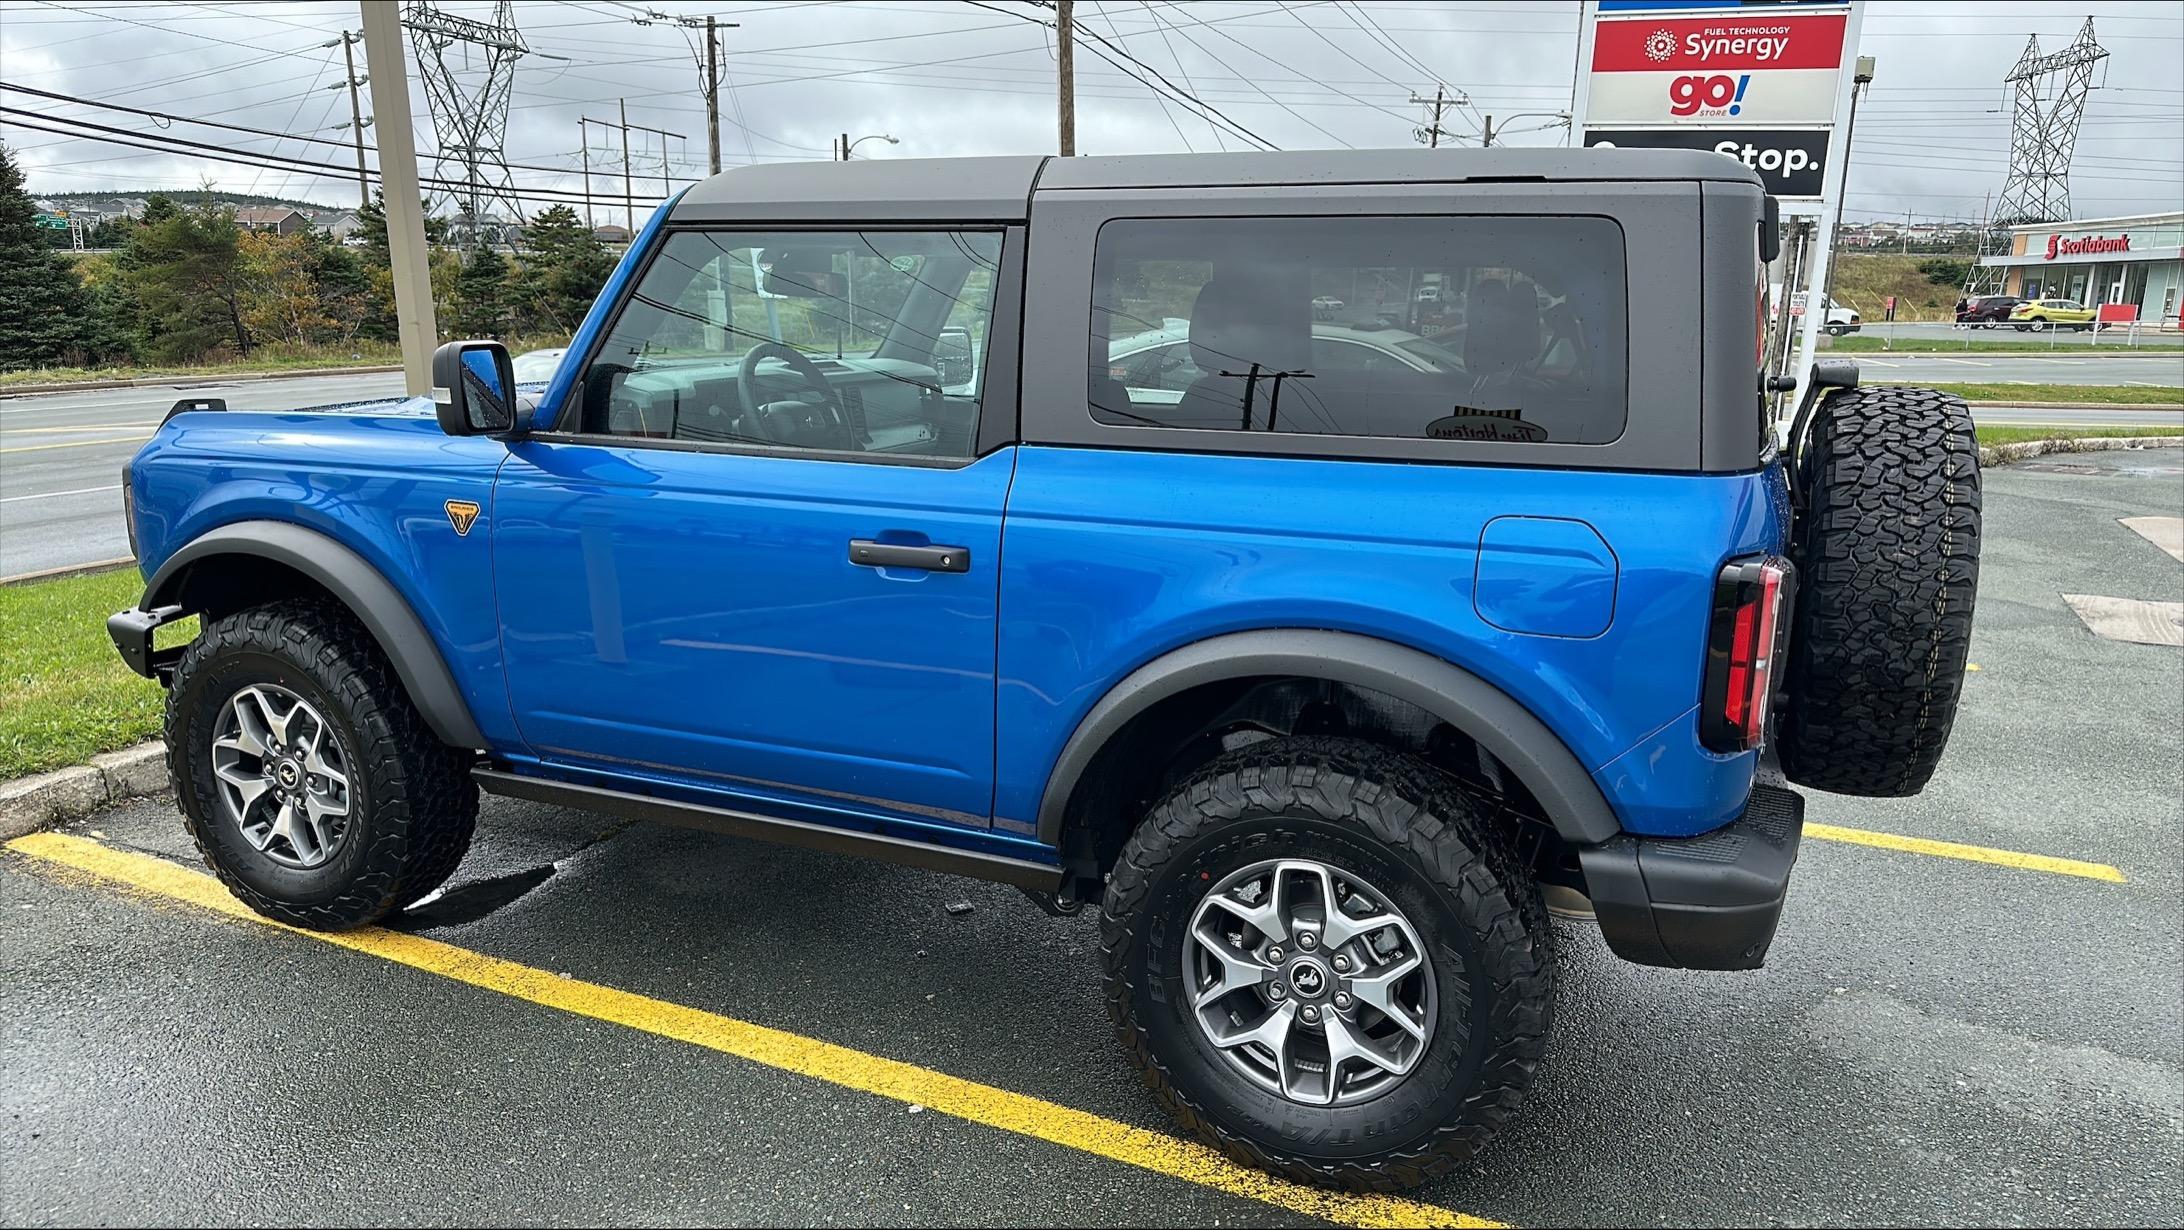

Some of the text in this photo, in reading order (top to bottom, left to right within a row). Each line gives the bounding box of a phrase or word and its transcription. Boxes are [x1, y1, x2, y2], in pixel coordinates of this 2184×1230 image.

[1729, 26, 1790, 35] TECHNOLOGY
[1685, 34, 1789, 60] Synergy
[1669, 75, 1751, 117] go!
[1699, 109, 1727, 117] STORE
[1714, 141, 1819, 178] Stop.
[2060, 235, 2130, 254] Scotiabank
